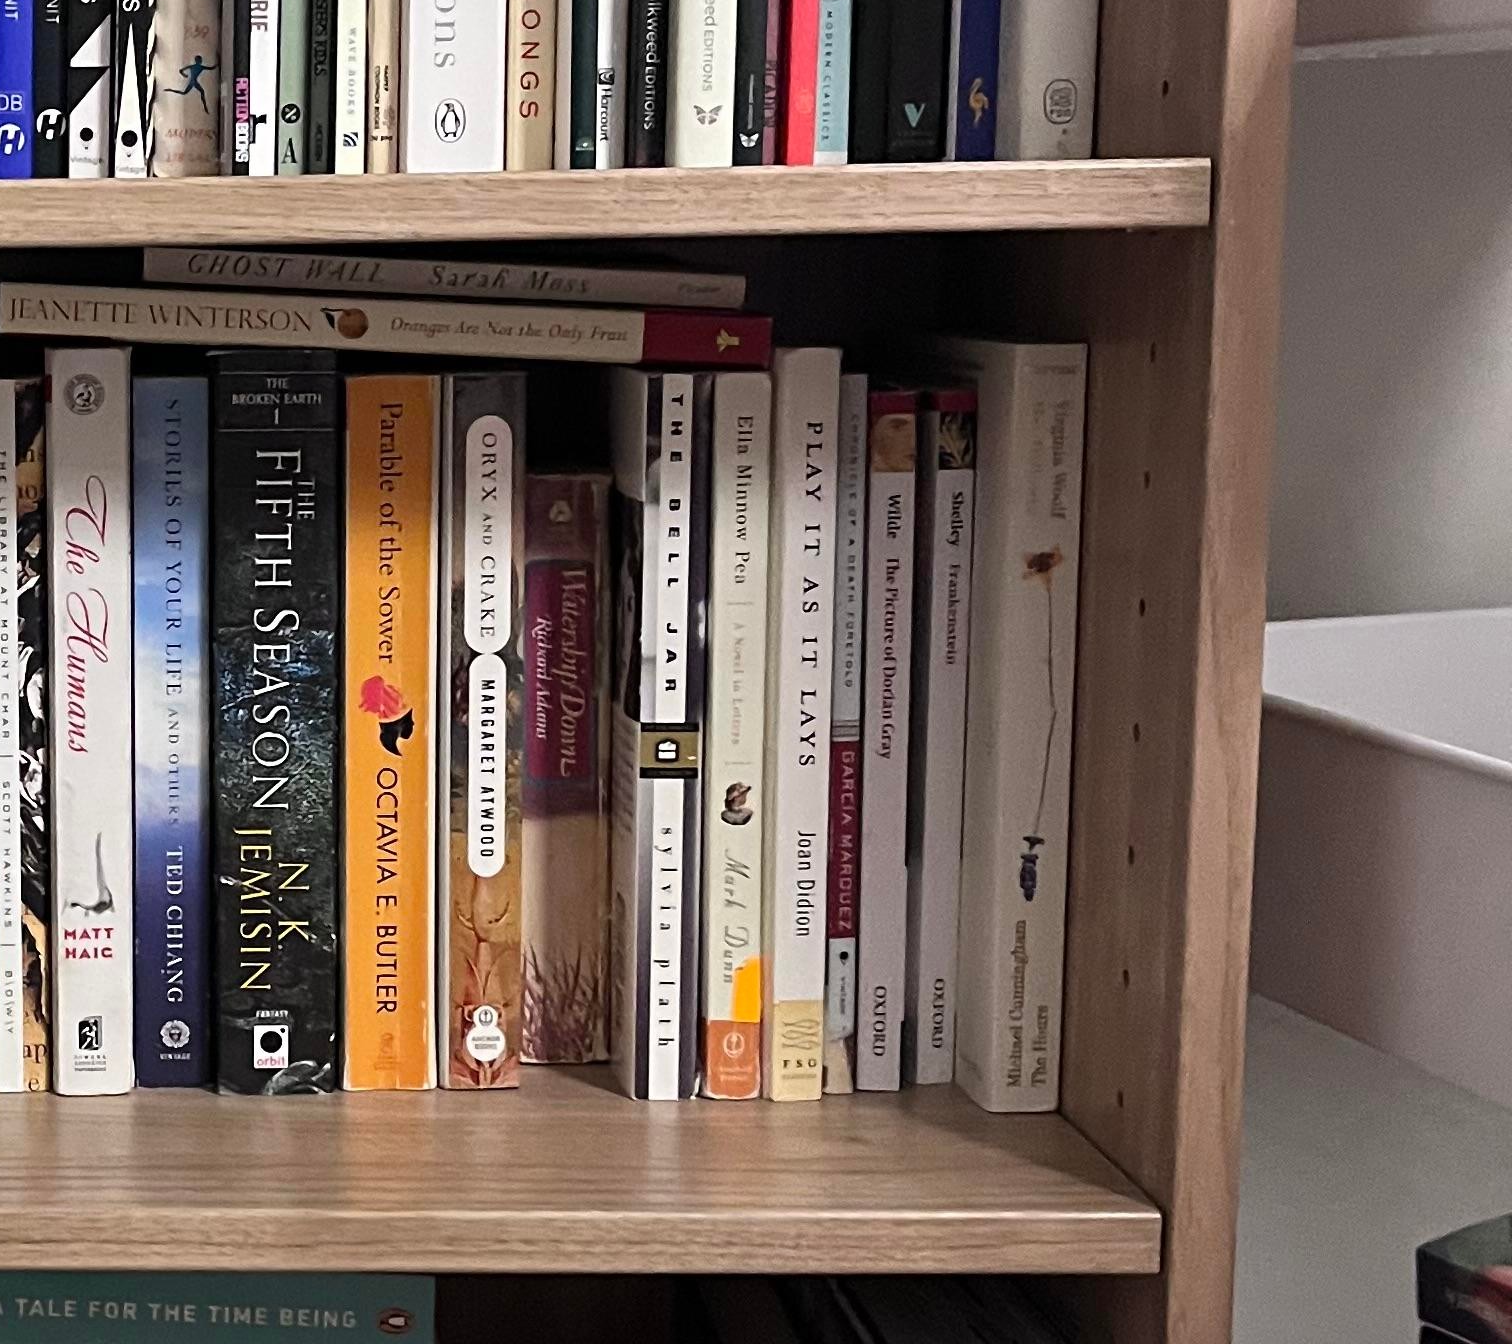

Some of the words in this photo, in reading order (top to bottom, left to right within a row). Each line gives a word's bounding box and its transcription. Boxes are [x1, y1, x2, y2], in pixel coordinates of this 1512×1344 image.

[9, 298, 137, 324] JEANETTE
[148, 306, 312, 332] WINTERSON
[380, 403, 403, 492] Parable
[670, 394, 684, 462] THE
[255, 449, 301, 588] FIFTH
[381, 502, 402, 527] of
[667, 499, 680, 587] BELL
[380, 531, 402, 576] the
[378, 586, 401, 665] Sower
[665, 623, 678, 692] JAR
[252, 608, 299, 809] SEASON
[376, 768, 399, 885] OCTAVIA
[797, 831, 816, 871] Joan
[166, 846, 184, 896] TED
[64, 928, 114, 940] MATT
[234, 828, 272, 990] JEMISIN
[376, 895, 397, 917] E.
[796, 880, 816, 937] Didion
[64, 947, 113, 959] HAIG
[166, 906, 184, 1004] CHIANG
[376, 926, 398, 1014] BUTLER
[872, 986, 888, 1057] OXFORD
[256, 1056, 286, 1066] orbit
[15, 1299, 78, 1318] TALE
[88, 1300, 137, 1322] FOR
[148, 1304, 198, 1323] THE
[209, 1306, 270, 1326] TIME
[279, 1308, 356, 1329] BEING
